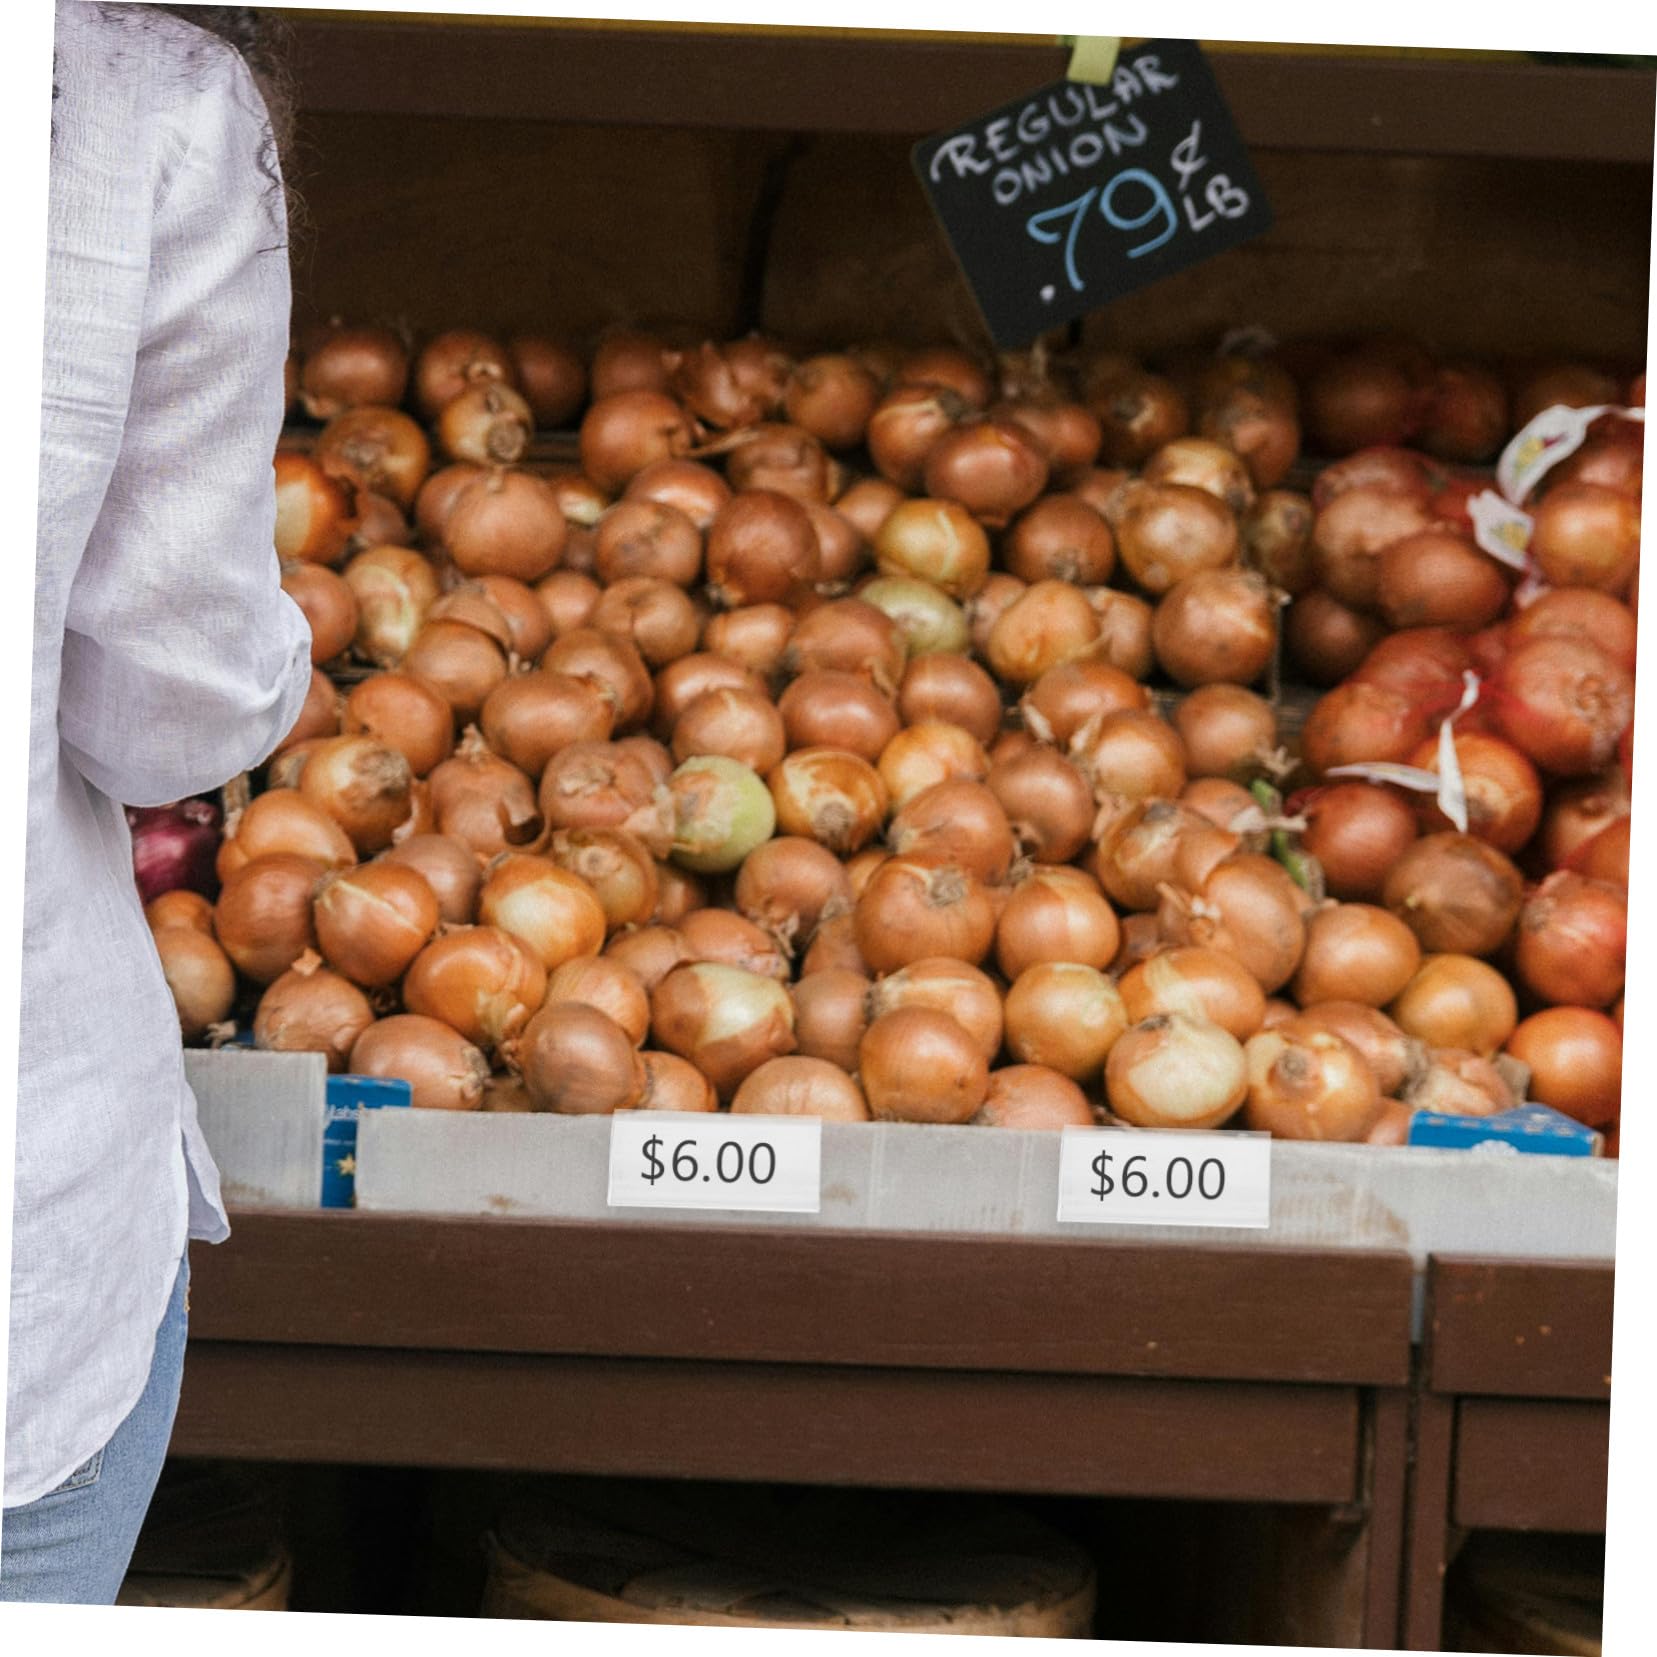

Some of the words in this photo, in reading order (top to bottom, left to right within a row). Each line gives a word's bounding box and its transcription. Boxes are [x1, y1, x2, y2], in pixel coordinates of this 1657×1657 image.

[929, 55, 1179, 183] REGULAR
[992, 112, 1148, 206] ONION
[1183, 173, 1250, 232] LB
[641, 1134, 776, 1186] $6.00
[1090, 1149, 1226, 1202] $6.00
